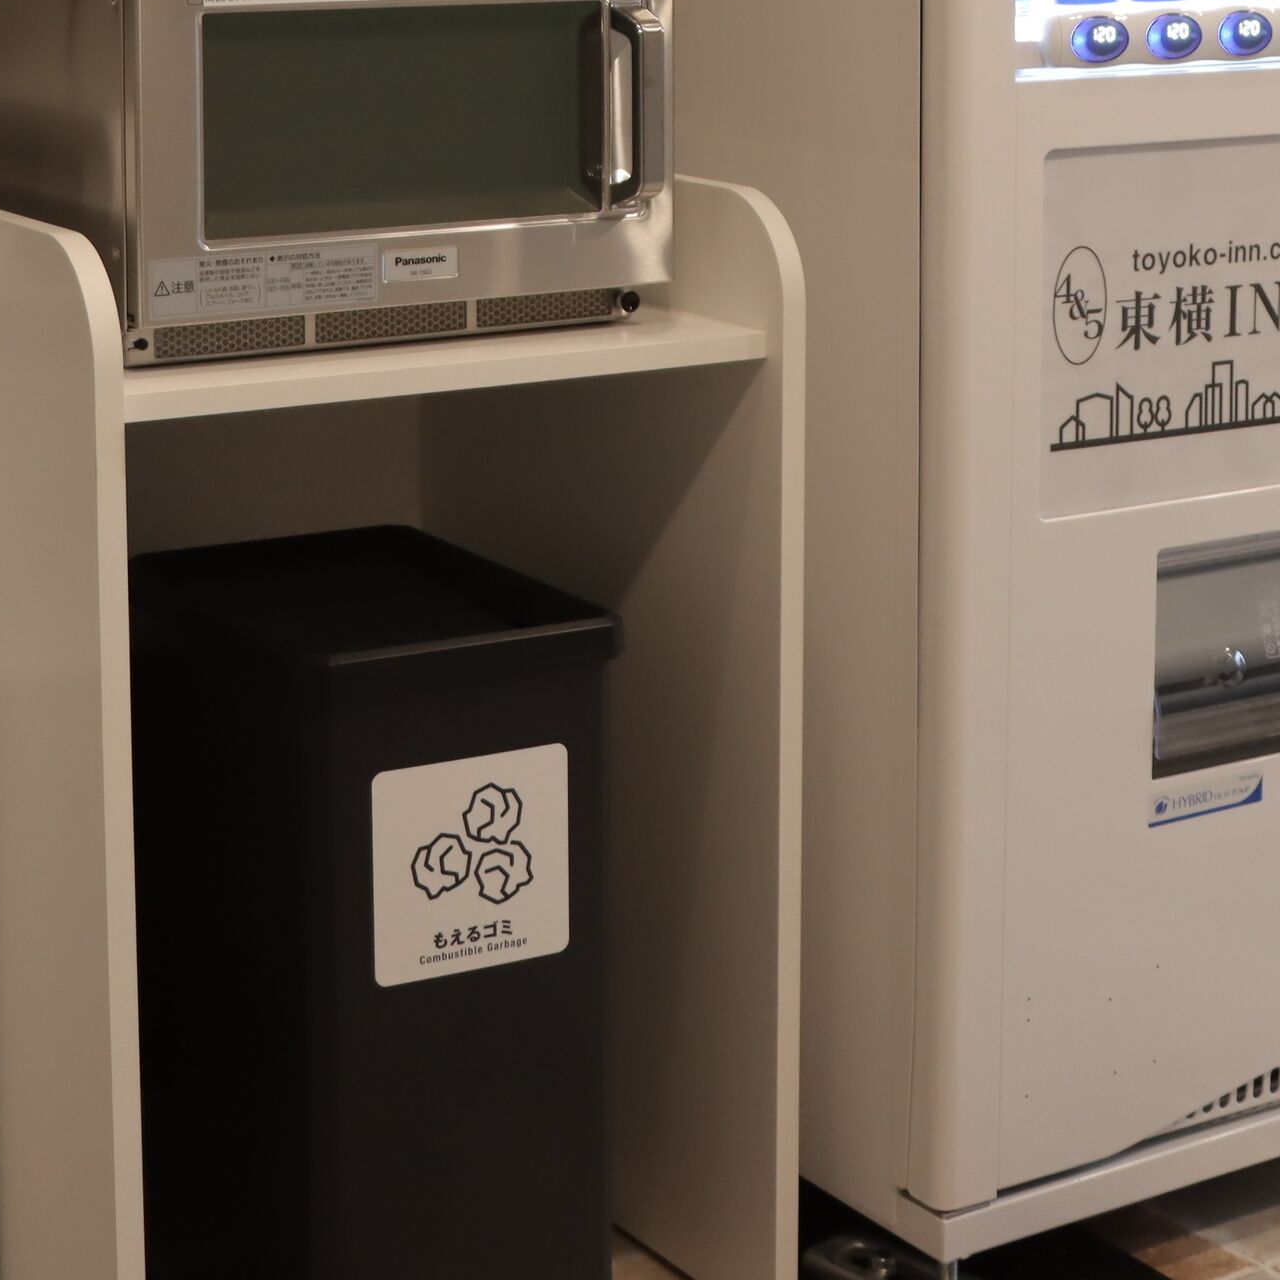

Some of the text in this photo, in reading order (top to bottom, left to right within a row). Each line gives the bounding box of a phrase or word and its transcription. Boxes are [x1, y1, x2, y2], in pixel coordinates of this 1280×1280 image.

[1094, 26, 1116, 43] 120
[1167, 23, 1189, 39] 120
[1239, 20, 1260, 36] 120
[394, 254, 447, 266] Panasonic
[171, 280, 195, 293] 注意
[434, 920, 512, 949] もえるゴミ
[420, 937, 528, 965] Combustible Garbage
